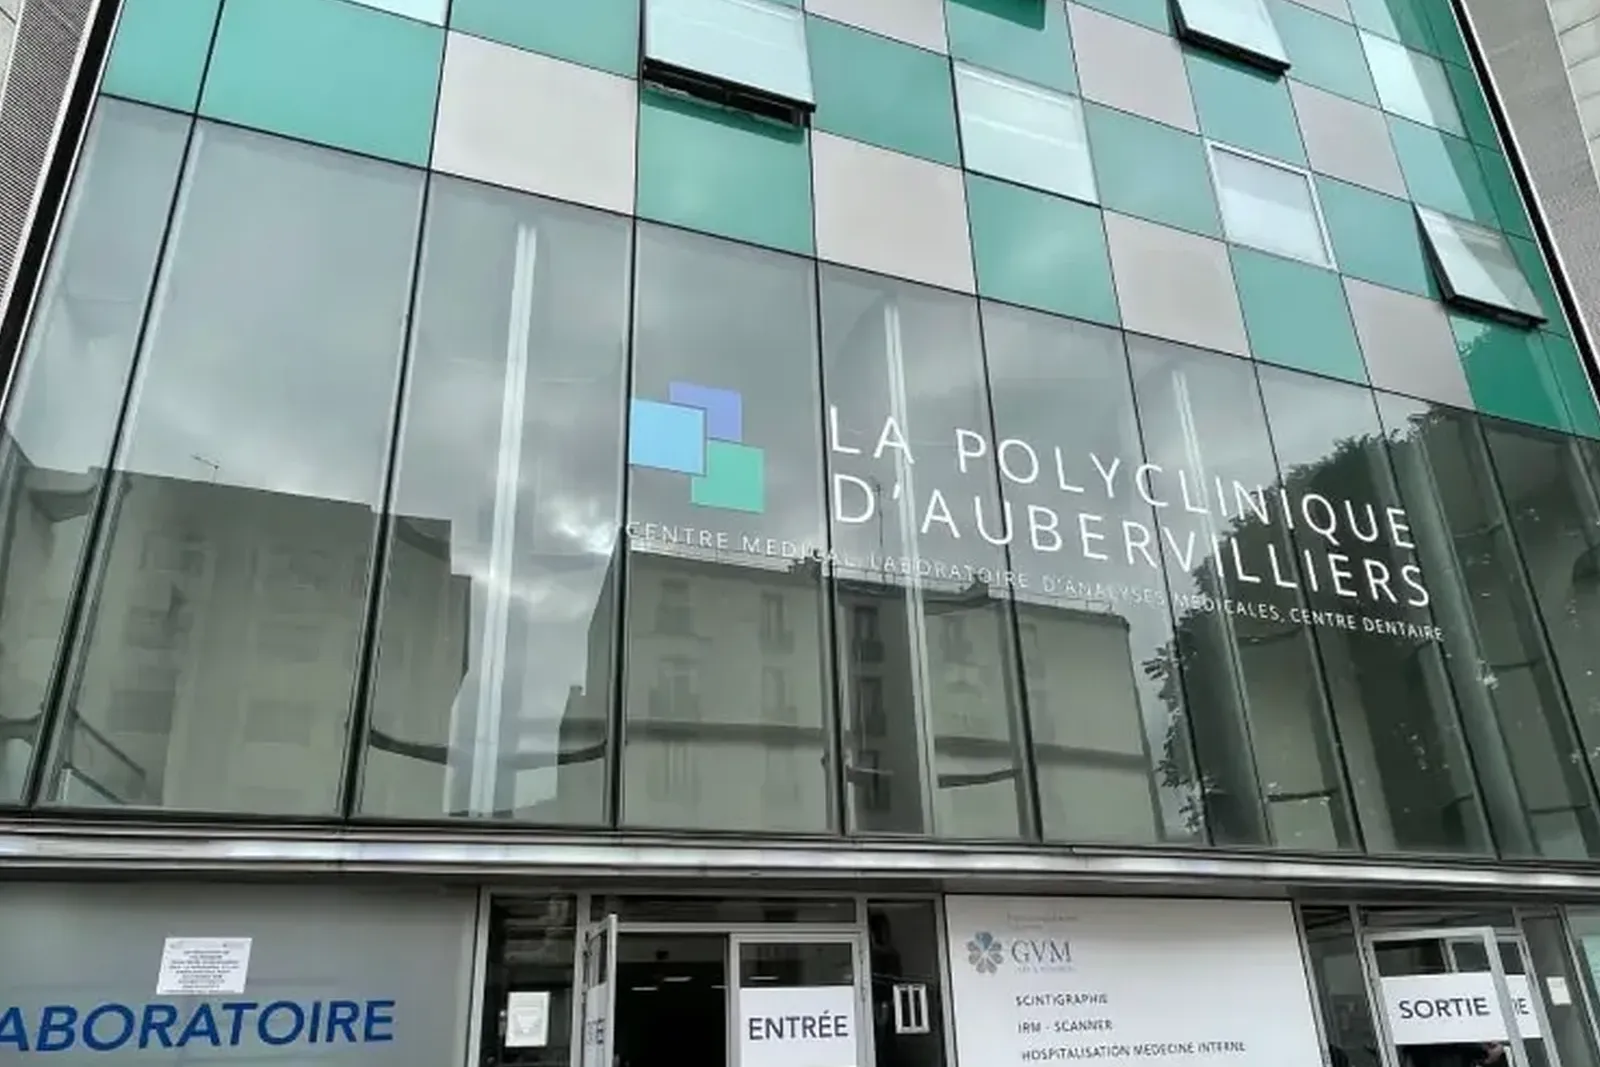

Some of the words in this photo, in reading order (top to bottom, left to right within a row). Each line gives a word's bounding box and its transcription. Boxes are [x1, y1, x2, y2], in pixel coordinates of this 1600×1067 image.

[829, 404, 914, 464] LA
[955, 427, 1415, 549] POLYCLINIQUE
[833, 473, 1430, 607] D'AUBERVILLIERS
[626, 521, 729, 550] CENTRE
[870, 552, 1029, 588] LABORATOIRE
[1289, 608, 1356, 630] CENTRE
[1362, 616, 1444, 642] DENTAIRE
[1011, 939, 1072, 963] GVM
[1016, 993, 1108, 1007] SCINTIGRAPHIE
[1399, 997, 1490, 1019] SORTIE
[749, 1010, 849, 1041] ENTRÉE
[1018, 1021, 1041, 1034] IRM
[1054, 1019, 1113, 1033] SCANNER
[1022, 1046, 1130, 1061] HOSPITALISATION
[1199, 1041, 1246, 1053] INTERNE
